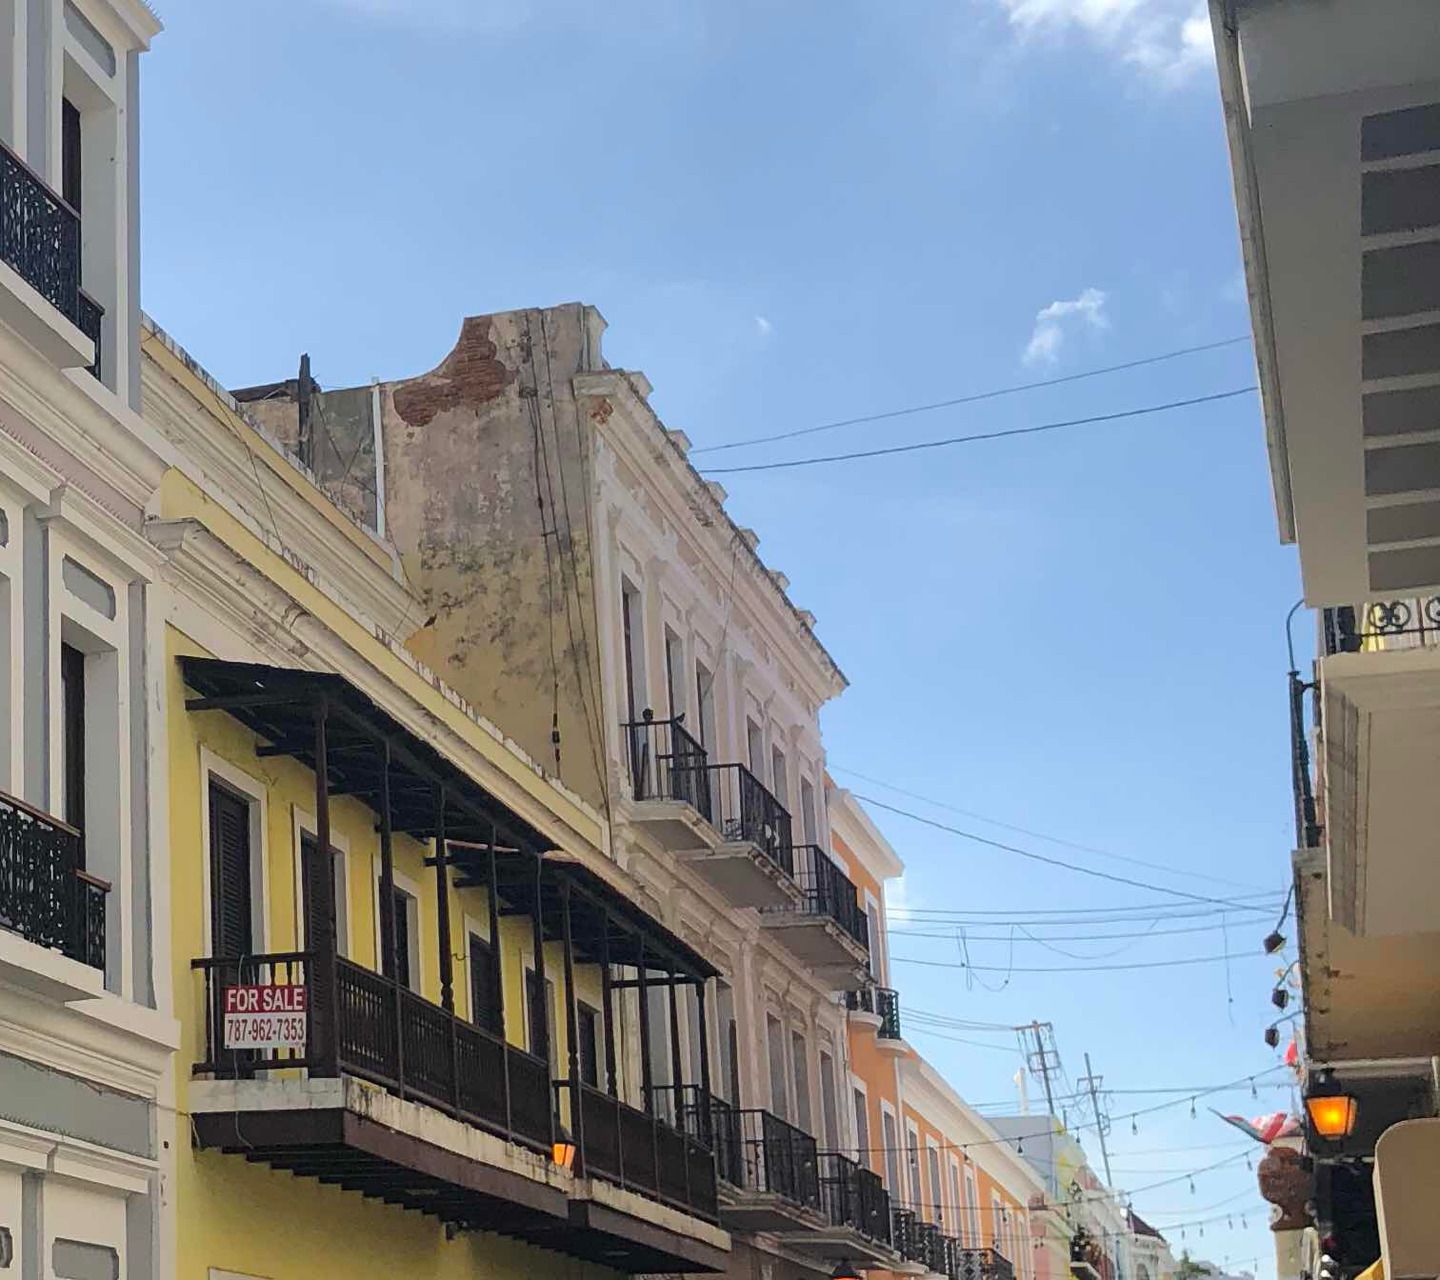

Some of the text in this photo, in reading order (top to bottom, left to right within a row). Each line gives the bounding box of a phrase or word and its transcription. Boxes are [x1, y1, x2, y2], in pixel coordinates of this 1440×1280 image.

[228, 988, 304, 1011] FOR SALE
[228, 1018, 304, 1041] 787-962-7353
